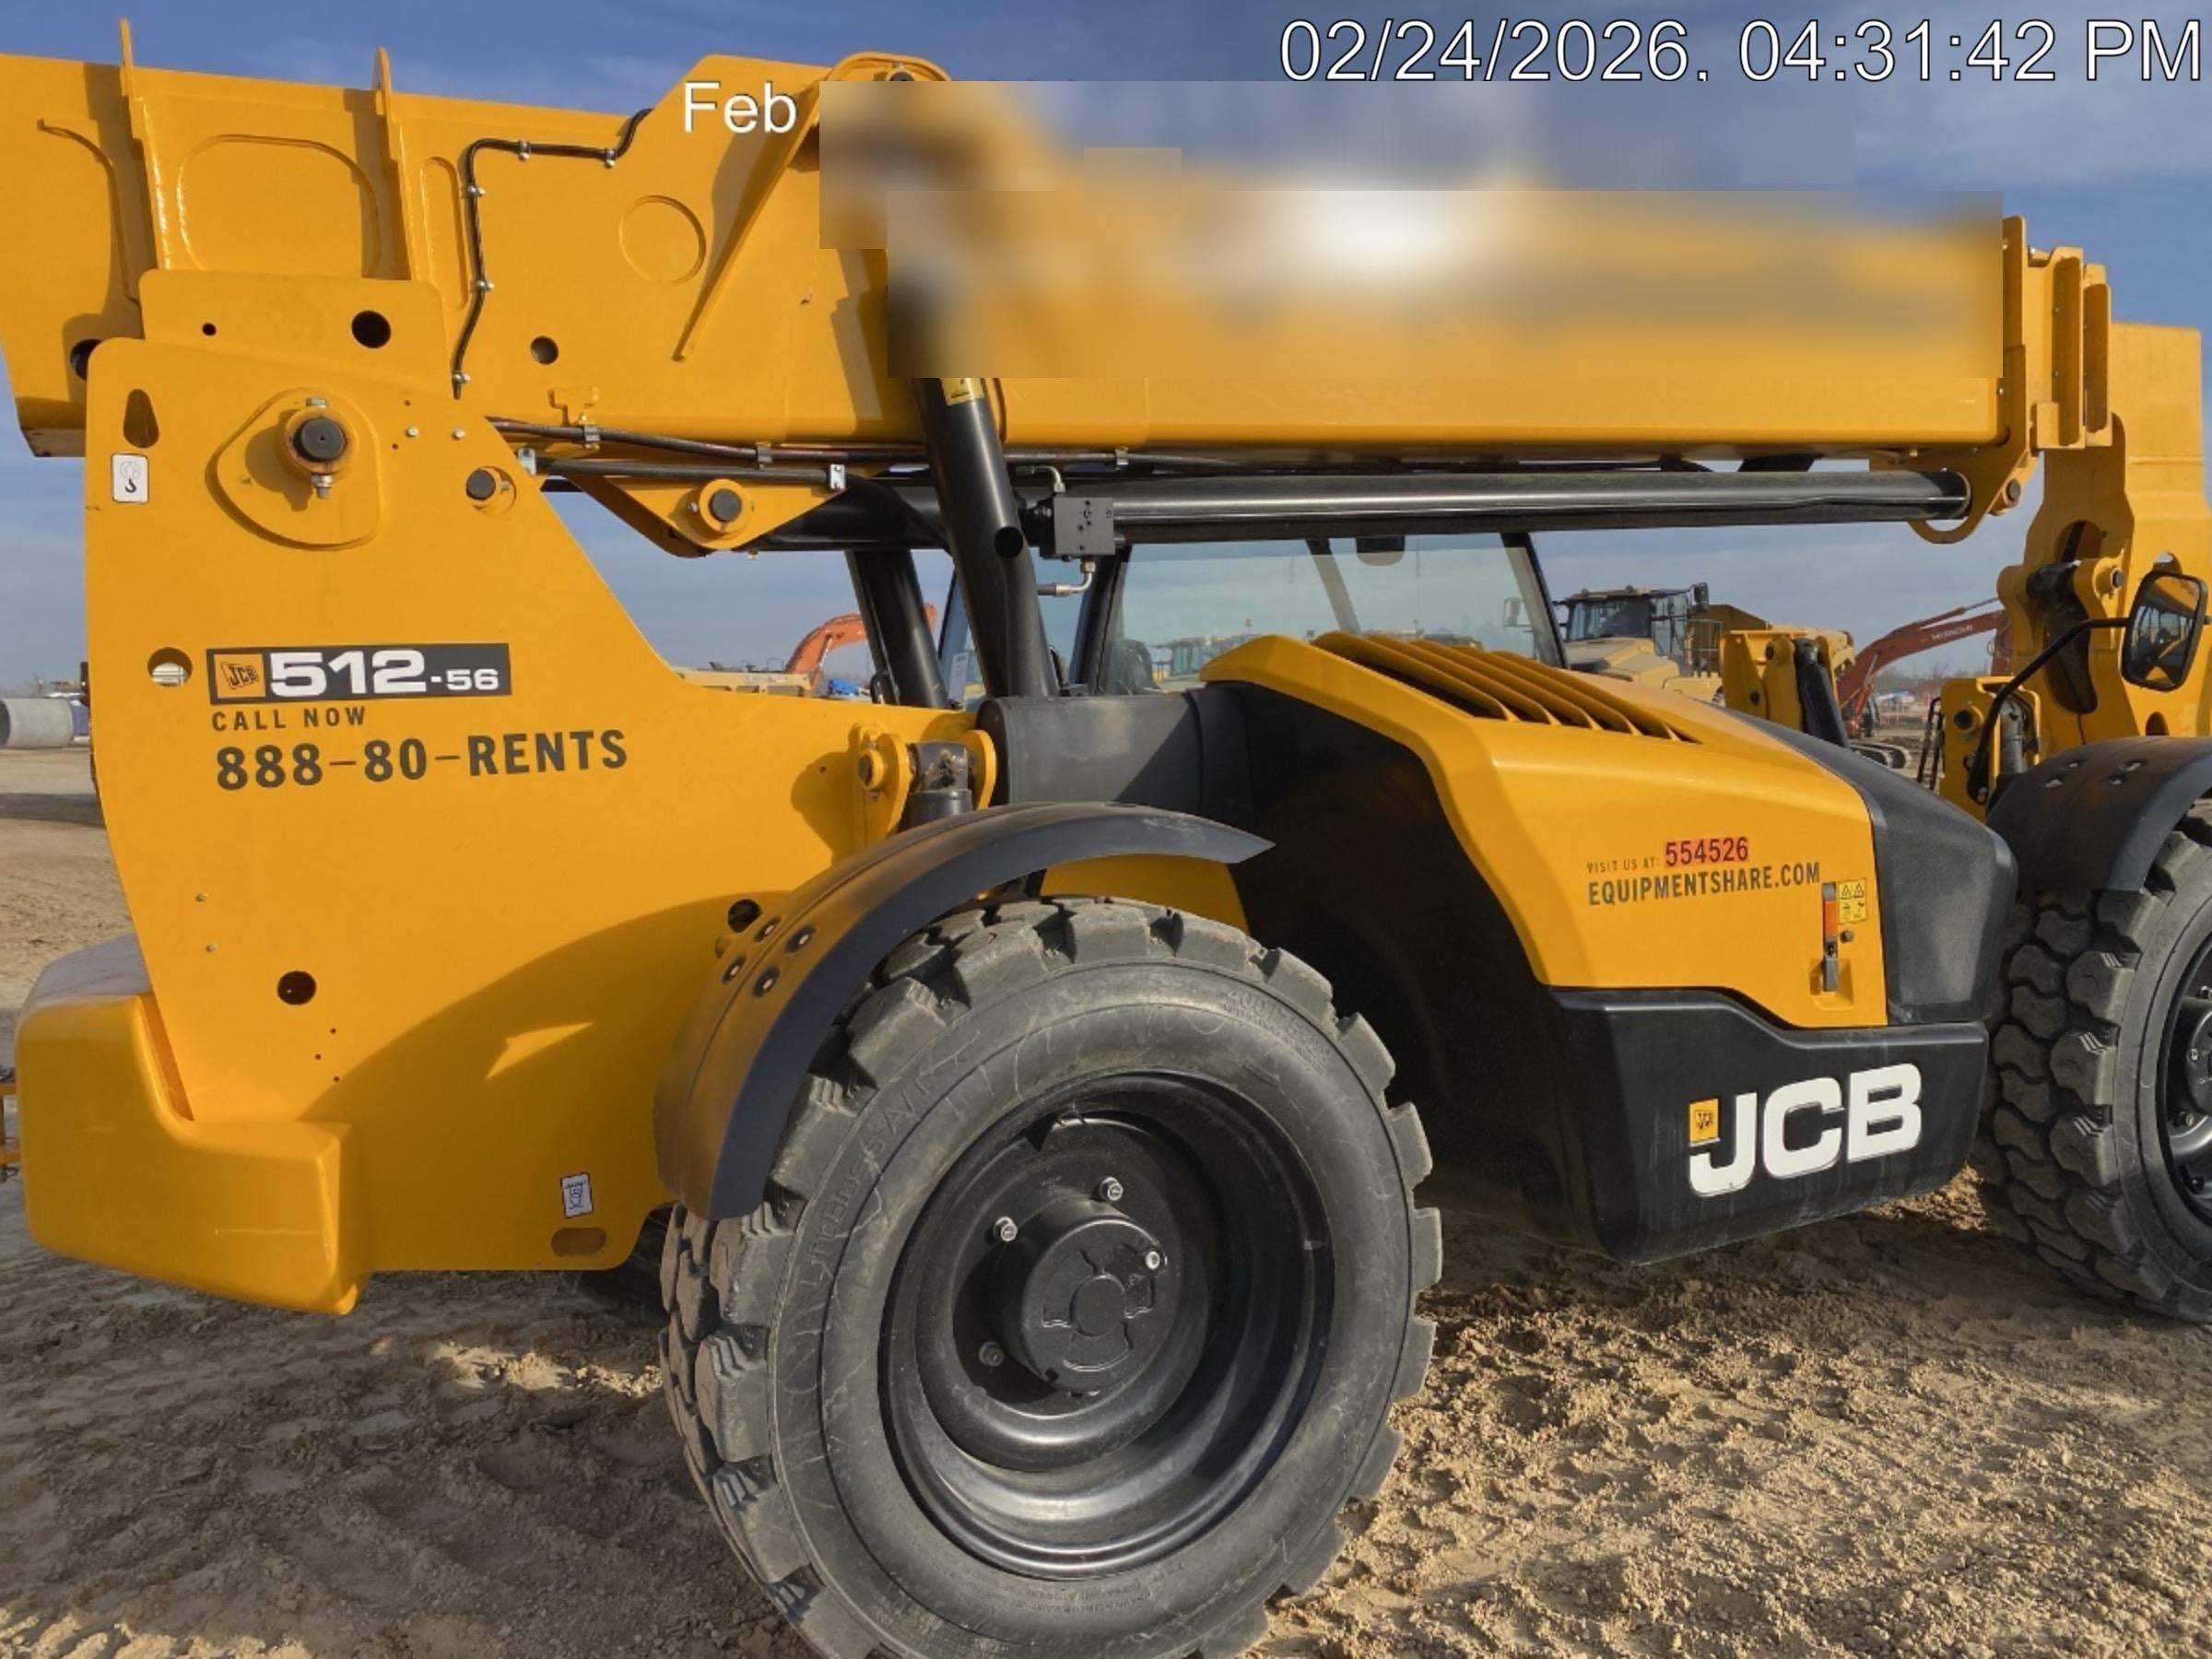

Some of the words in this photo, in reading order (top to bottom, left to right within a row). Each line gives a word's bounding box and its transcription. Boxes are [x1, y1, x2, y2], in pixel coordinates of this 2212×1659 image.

[270, 649, 499, 698] 512-56
[212, 710, 287, 731] CALL
[303, 706, 365, 727] NOW
[217, 729, 628, 791] 888-80-RENTS
[1586, 860, 1618, 873] VISIT
[1623, 857, 1638, 870] US
[1665, 836, 1748, 867] 554526
[1588, 861, 1820, 905] EQUIPMENTSHARE.COM
[1690, 1064, 1922, 1197] JCB
